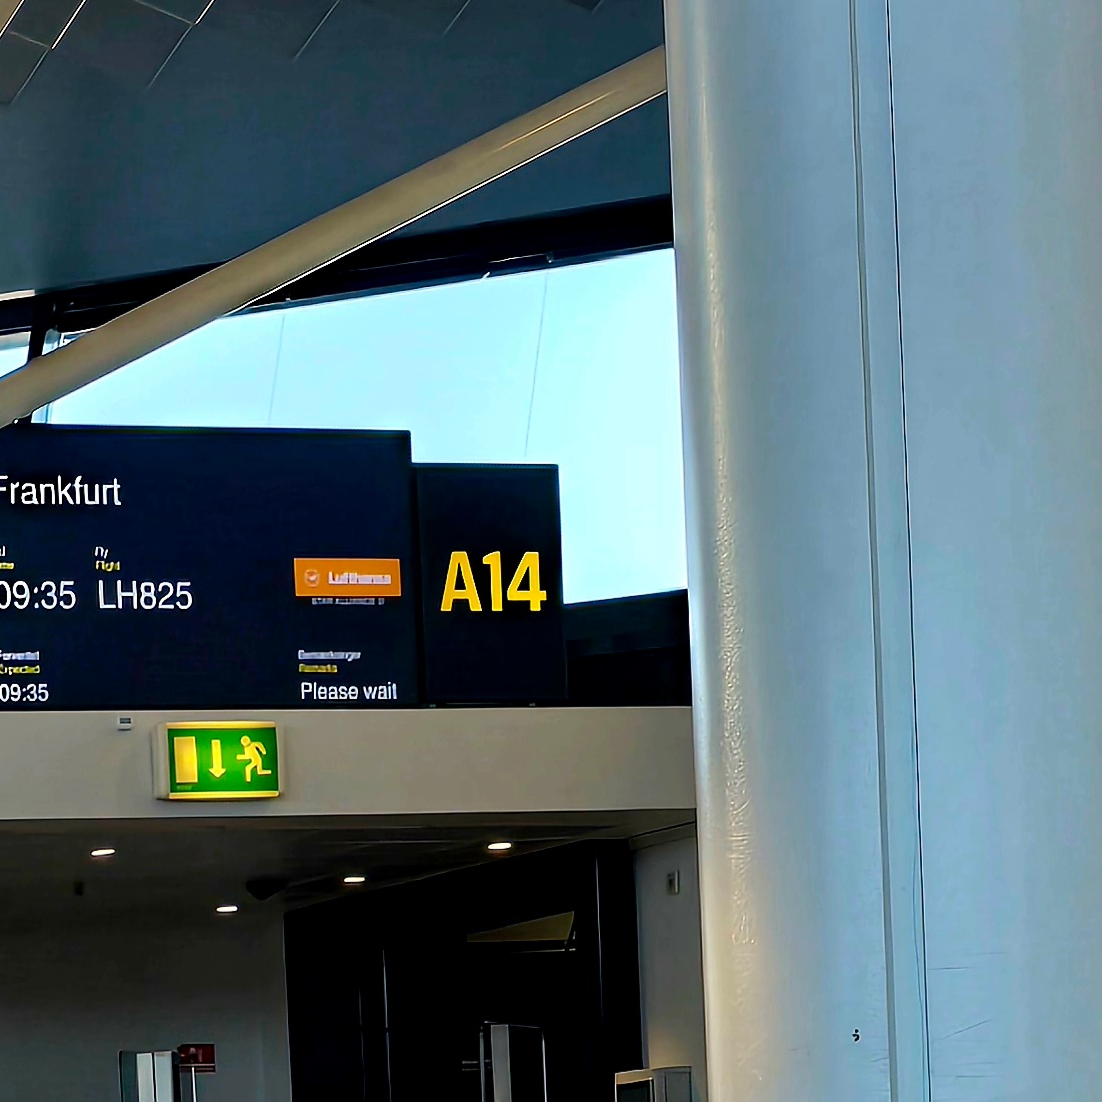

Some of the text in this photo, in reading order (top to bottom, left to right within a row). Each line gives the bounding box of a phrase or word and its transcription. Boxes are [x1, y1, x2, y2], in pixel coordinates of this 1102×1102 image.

[440, 551, 547, 612] A14
[98, 579, 193, 609] LH825
[0, 683, 49, 702] 09:35
[301, 681, 398, 700] Please wait
